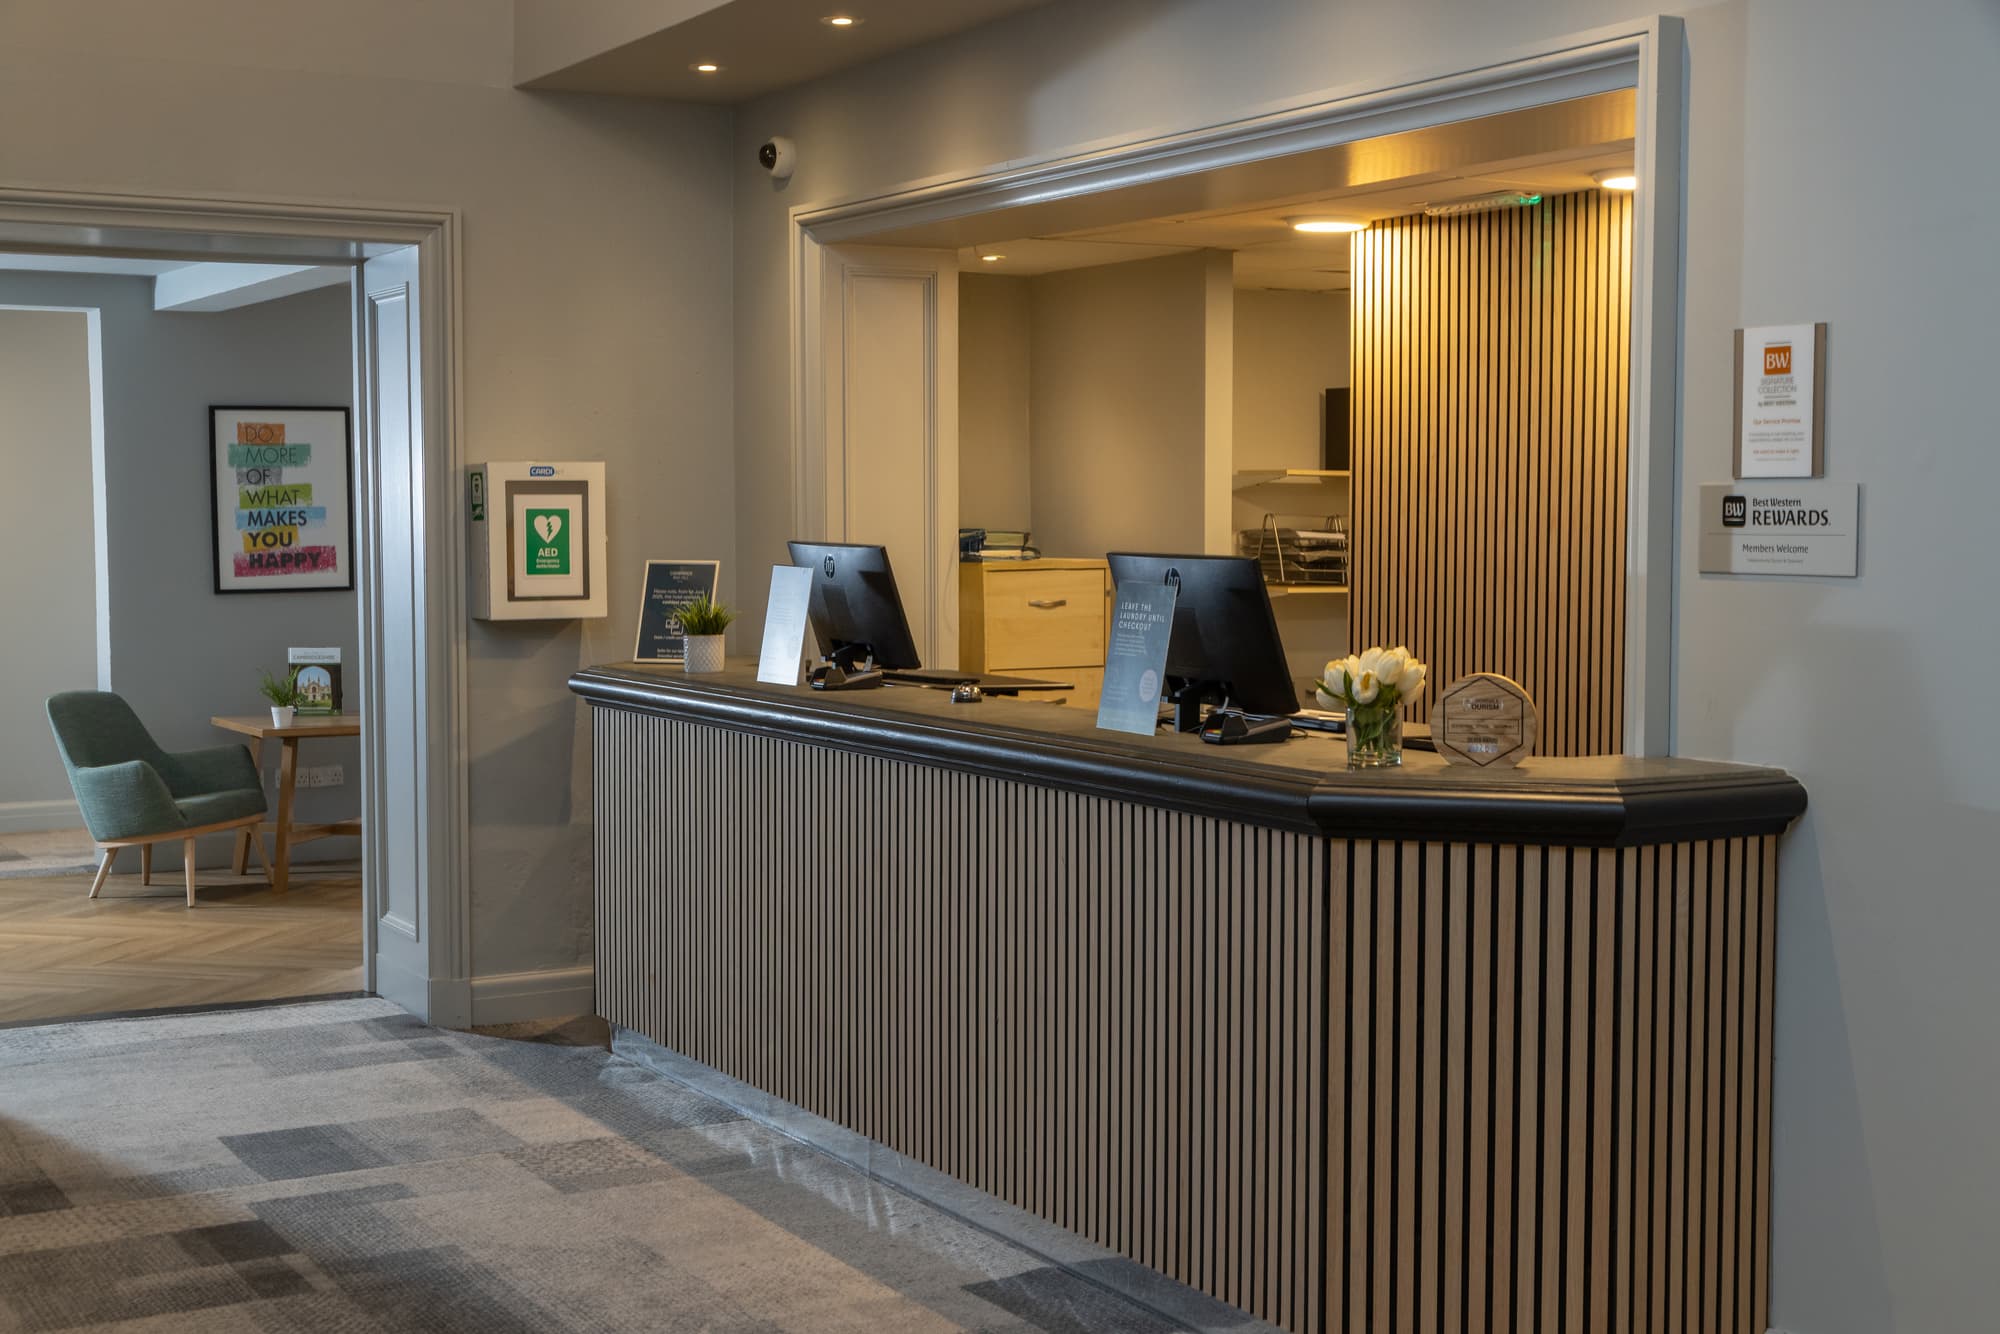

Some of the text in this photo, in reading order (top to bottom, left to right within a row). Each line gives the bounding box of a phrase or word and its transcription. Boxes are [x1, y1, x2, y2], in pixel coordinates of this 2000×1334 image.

[1766, 351, 1789, 369] BW
[1758, 385, 1797, 394] COLLECTION
[244, 425, 274, 442] DO
[245, 447, 297, 464] MORE
[246, 468, 271, 485] OF
[247, 489, 300, 505] WHAT
[1752, 498, 1802, 507] Best Western
[1725, 502, 1744, 516] BW
[247, 511, 307, 527] MAKES
[1752, 509, 1829, 526] REWARDS
[248, 532, 292, 548] YOU
[537, 547, 558, 557] AED
[1742, 543, 1809, 554] Members Welcome
[249, 552, 320, 569] HAPPY
[1121, 601, 1152, 612] LEAVE THE
[1119, 612, 1165, 623] LAUNDRY UNTIL
[1118, 621, 1152, 631] CHECKOUT
